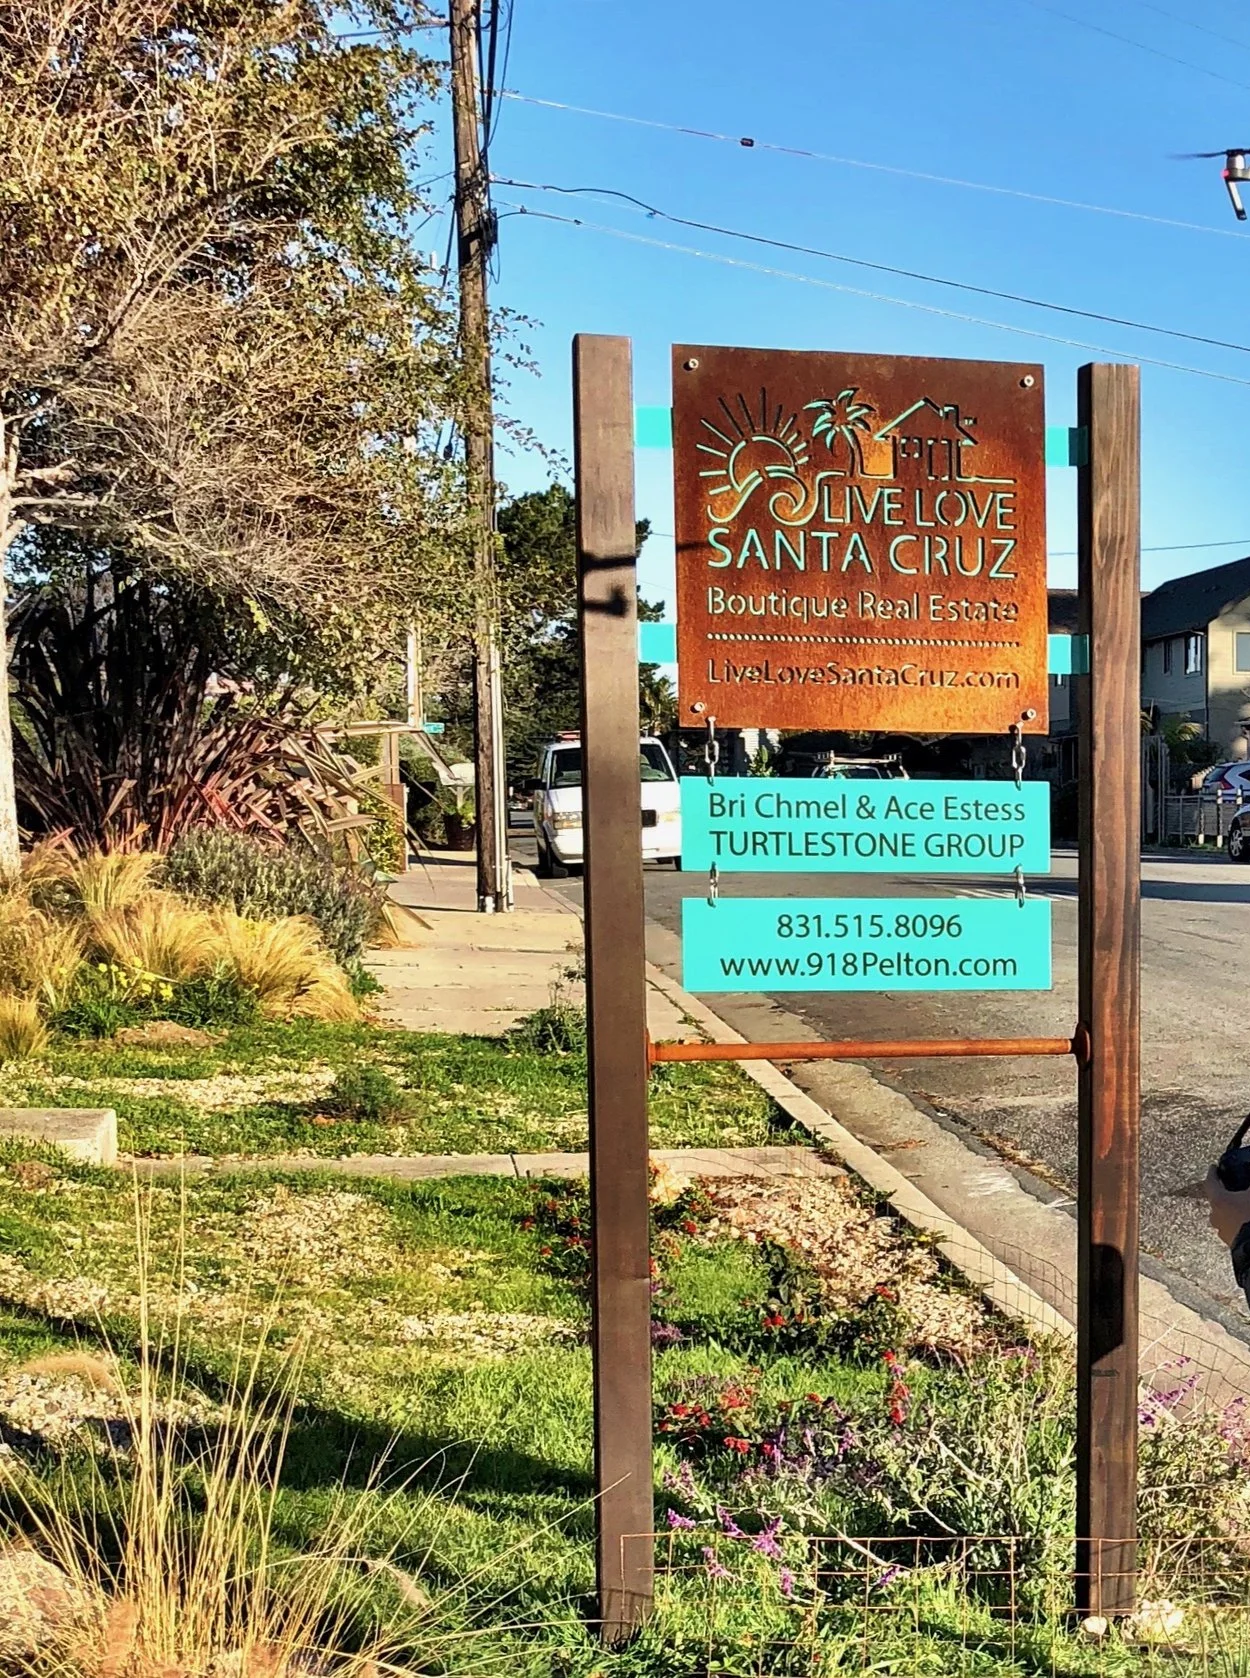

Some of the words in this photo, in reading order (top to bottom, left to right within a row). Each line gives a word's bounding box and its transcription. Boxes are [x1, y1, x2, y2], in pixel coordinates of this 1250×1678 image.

[822, 485, 903, 527] LIVE
[915, 488, 1018, 530] LOVE
[707, 527, 873, 573] SANTA
[889, 534, 1018, 579] CRUZ
[708, 586, 848, 623] Boutique
[858, 591, 919, 621] Real
[930, 594, 1019, 623] Estate
[707, 659, 1020, 689] LiveLoveSantaCruz.com
[709, 792, 746, 819] Bri
[754, 793, 847, 820] Chmel
[855, 795, 877, 820] &
[884, 796, 935, 820] Ace
[944, 796, 1026, 822] Estess
[709, 830, 916, 858] TURTLESTONE
[924, 833, 1025, 858] GROUP
[776, 914, 963, 938] 831.515.8096
[719, 952, 1018, 977] www.918Pelton.com
